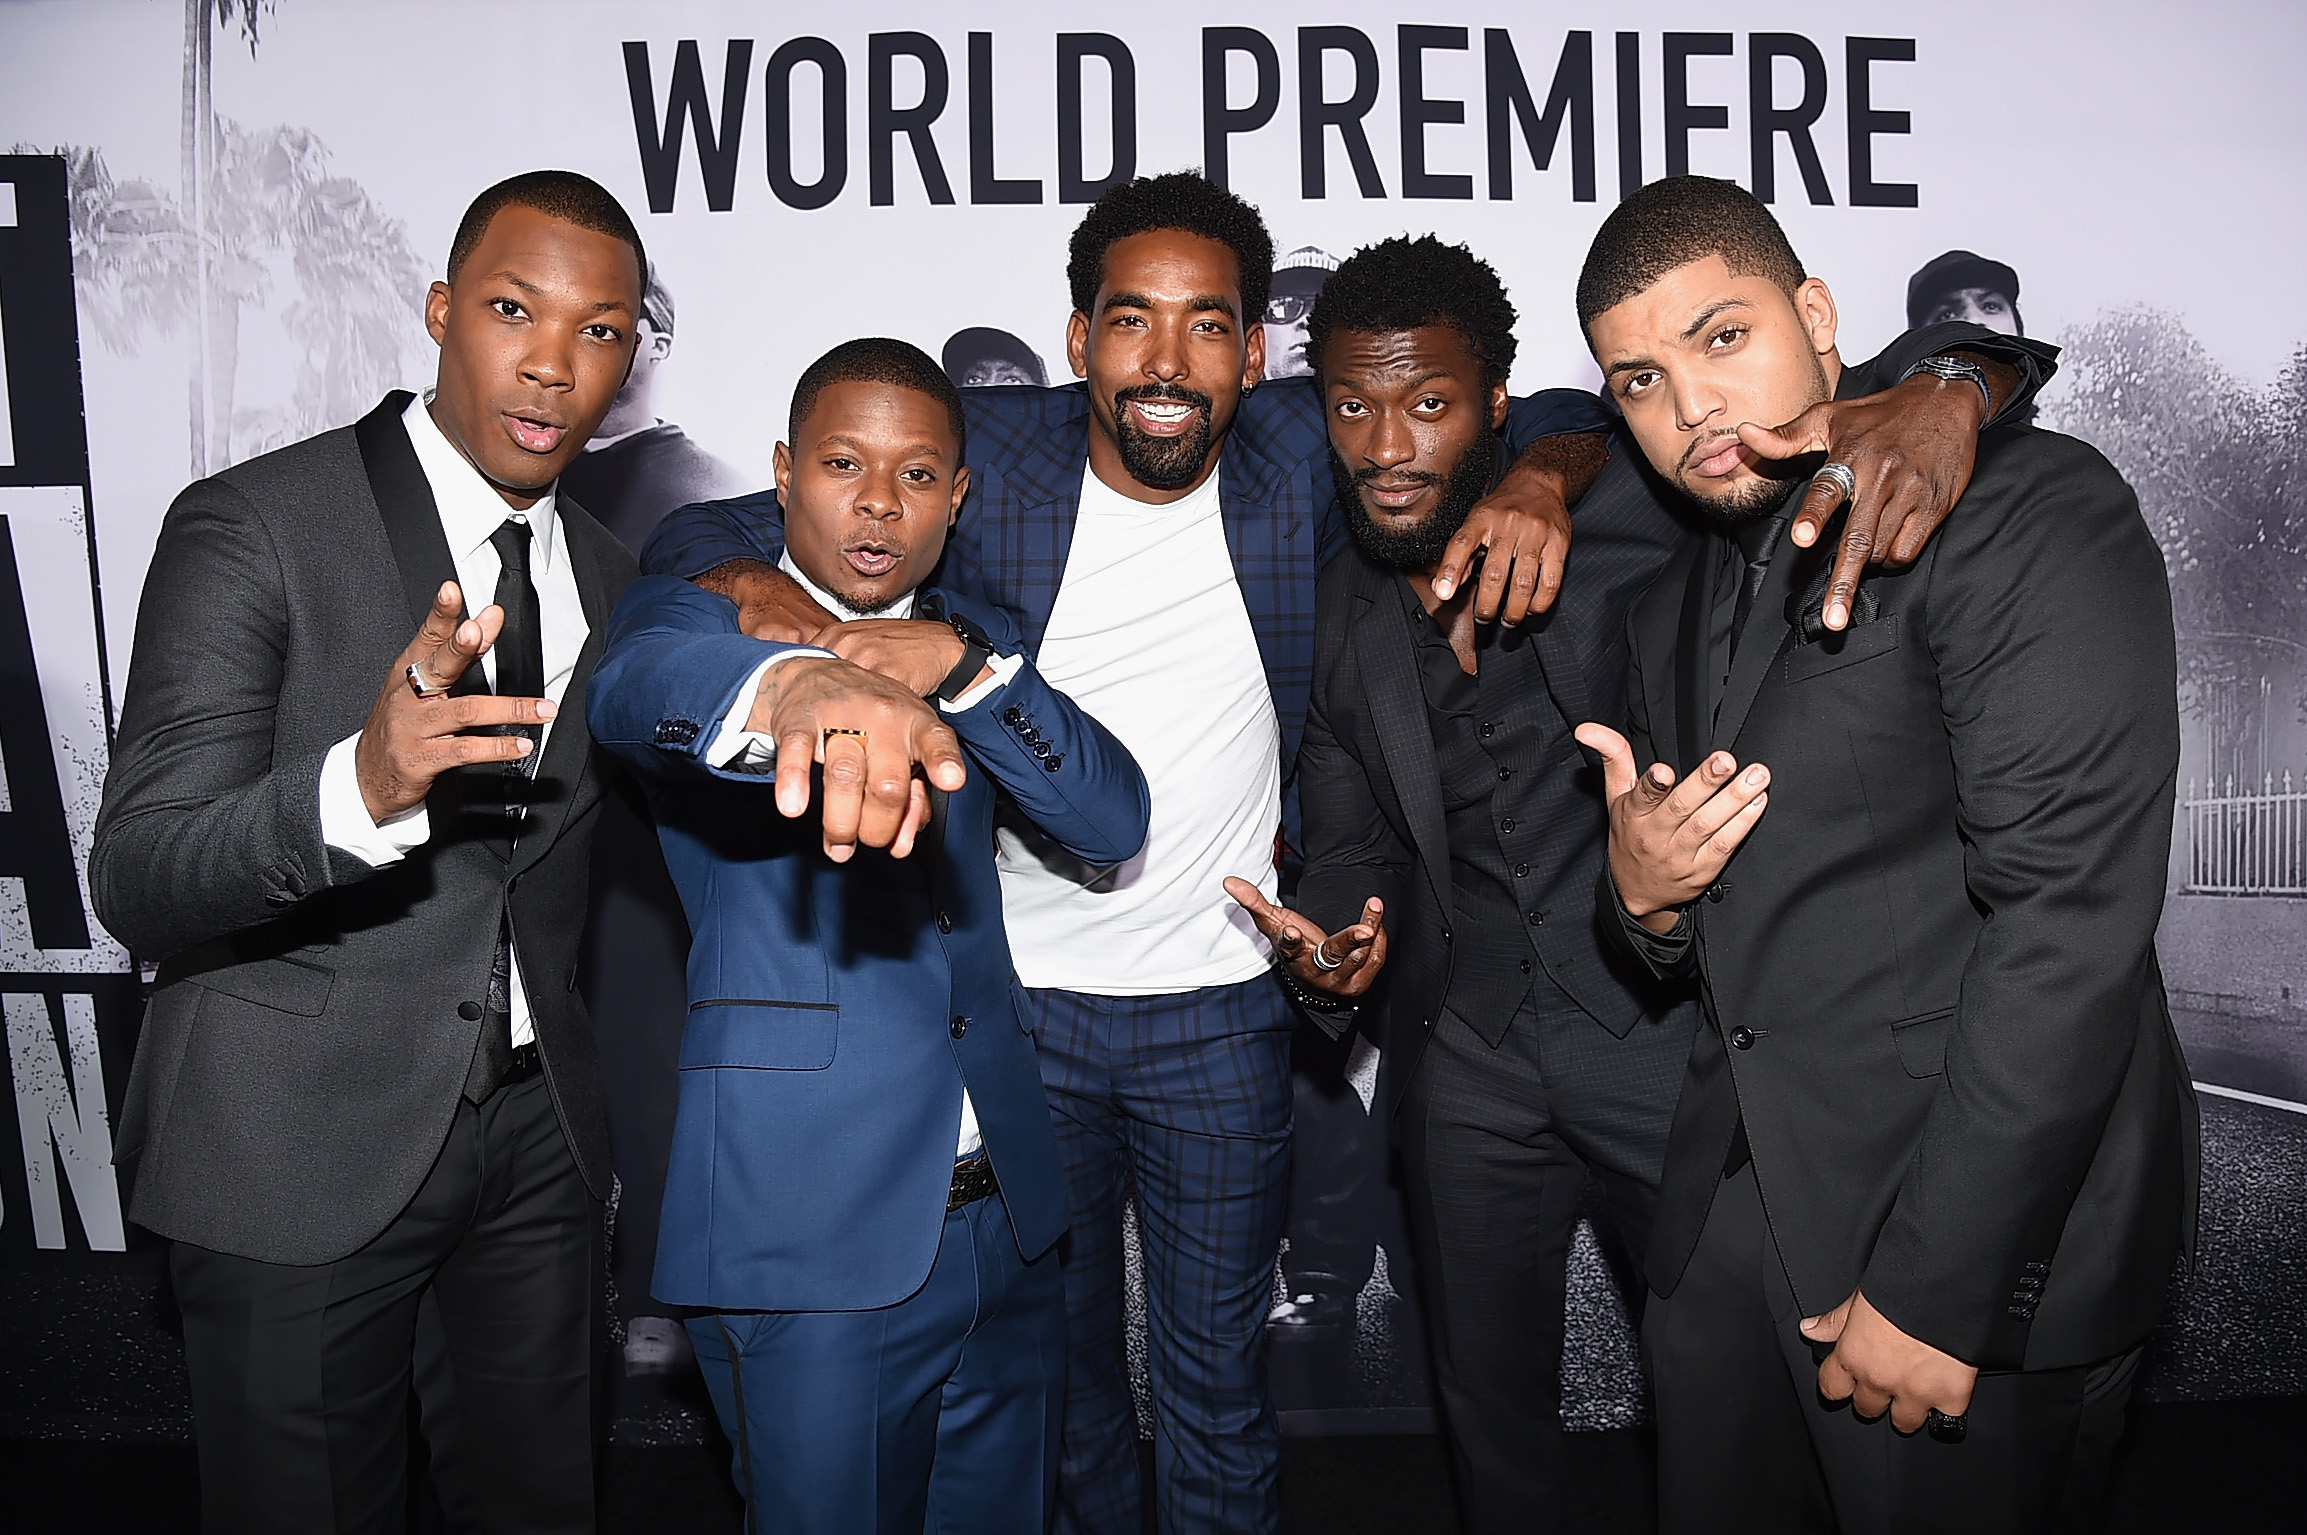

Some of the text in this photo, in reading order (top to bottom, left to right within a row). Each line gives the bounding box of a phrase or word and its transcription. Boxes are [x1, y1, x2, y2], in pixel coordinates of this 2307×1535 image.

[622, 24, 1919, 213] WORLD PREMIERE
[0, 992, 127, 1252] N
